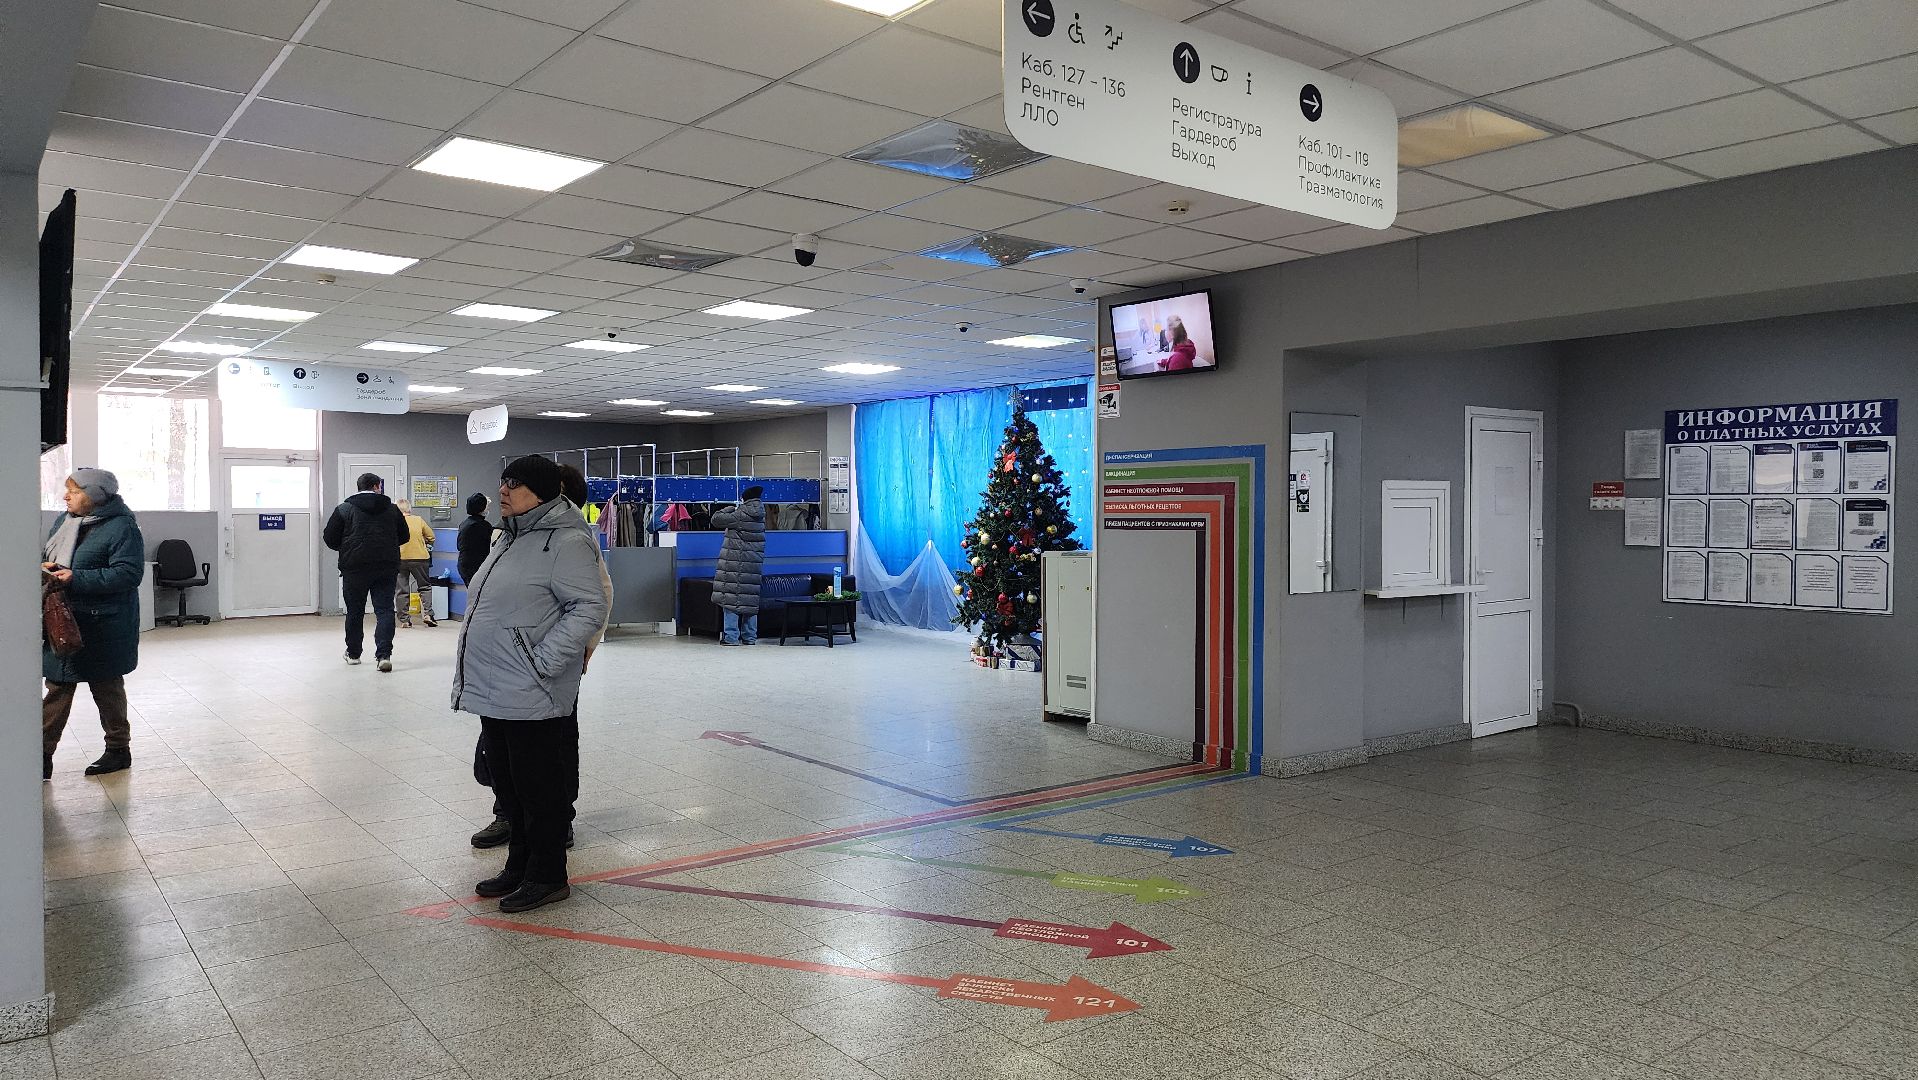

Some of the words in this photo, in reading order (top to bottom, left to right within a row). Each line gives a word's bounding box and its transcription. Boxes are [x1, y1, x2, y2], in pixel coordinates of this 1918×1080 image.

[1021, 52, 1056, 78] Каб.
[1061, 64, 1086, 85] 127
[1102, 77, 1126, 98] 136
[1021, 76, 1085, 111] Рентген
[1020, 101, 1059, 126] ЛЛО
[1172, 97, 1262, 138] Регистратура
[1172, 119, 1237, 152] Гардероб
[1171, 142, 1216, 170] Выход
[1298, 134, 1323, 155] Каб.
[1326, 142, 1343, 160] 101
[1355, 150, 1369, 167] 119
[1298, 155, 1381, 189] Профилактика
[1298, 175, 1384, 210] Травматология
[1677, 401, 1883, 427] ИНФОРМАЦИЯ
[1677, 430, 1689, 441] О
[1694, 425, 1788, 441] ПЛАТНЫХ
[1791, 421, 1883, 437] УСЛУГАХ
[1160, 486, 1184, 494] ПОМОЩИ
[1190, 845, 1220, 853] 107
[1006, 929, 1059, 940] ПОМОЩИ
[1010, 926, 1090, 940] НЕОТЛОЖНОЙ
[1013, 922, 1064, 932] КАБИНЕТ
[1116, 938, 1149, 948] 101
[957, 982, 1015, 993] ВЫПИСКИ
[960, 977, 1015, 987] КАБИНЕТ
[950, 990, 1004, 1000] СРЕДСТВ
[953, 986, 1057, 1003] ЛЕКАРСТВЕННЫХ
[1072, 996, 1116, 1009] 121
